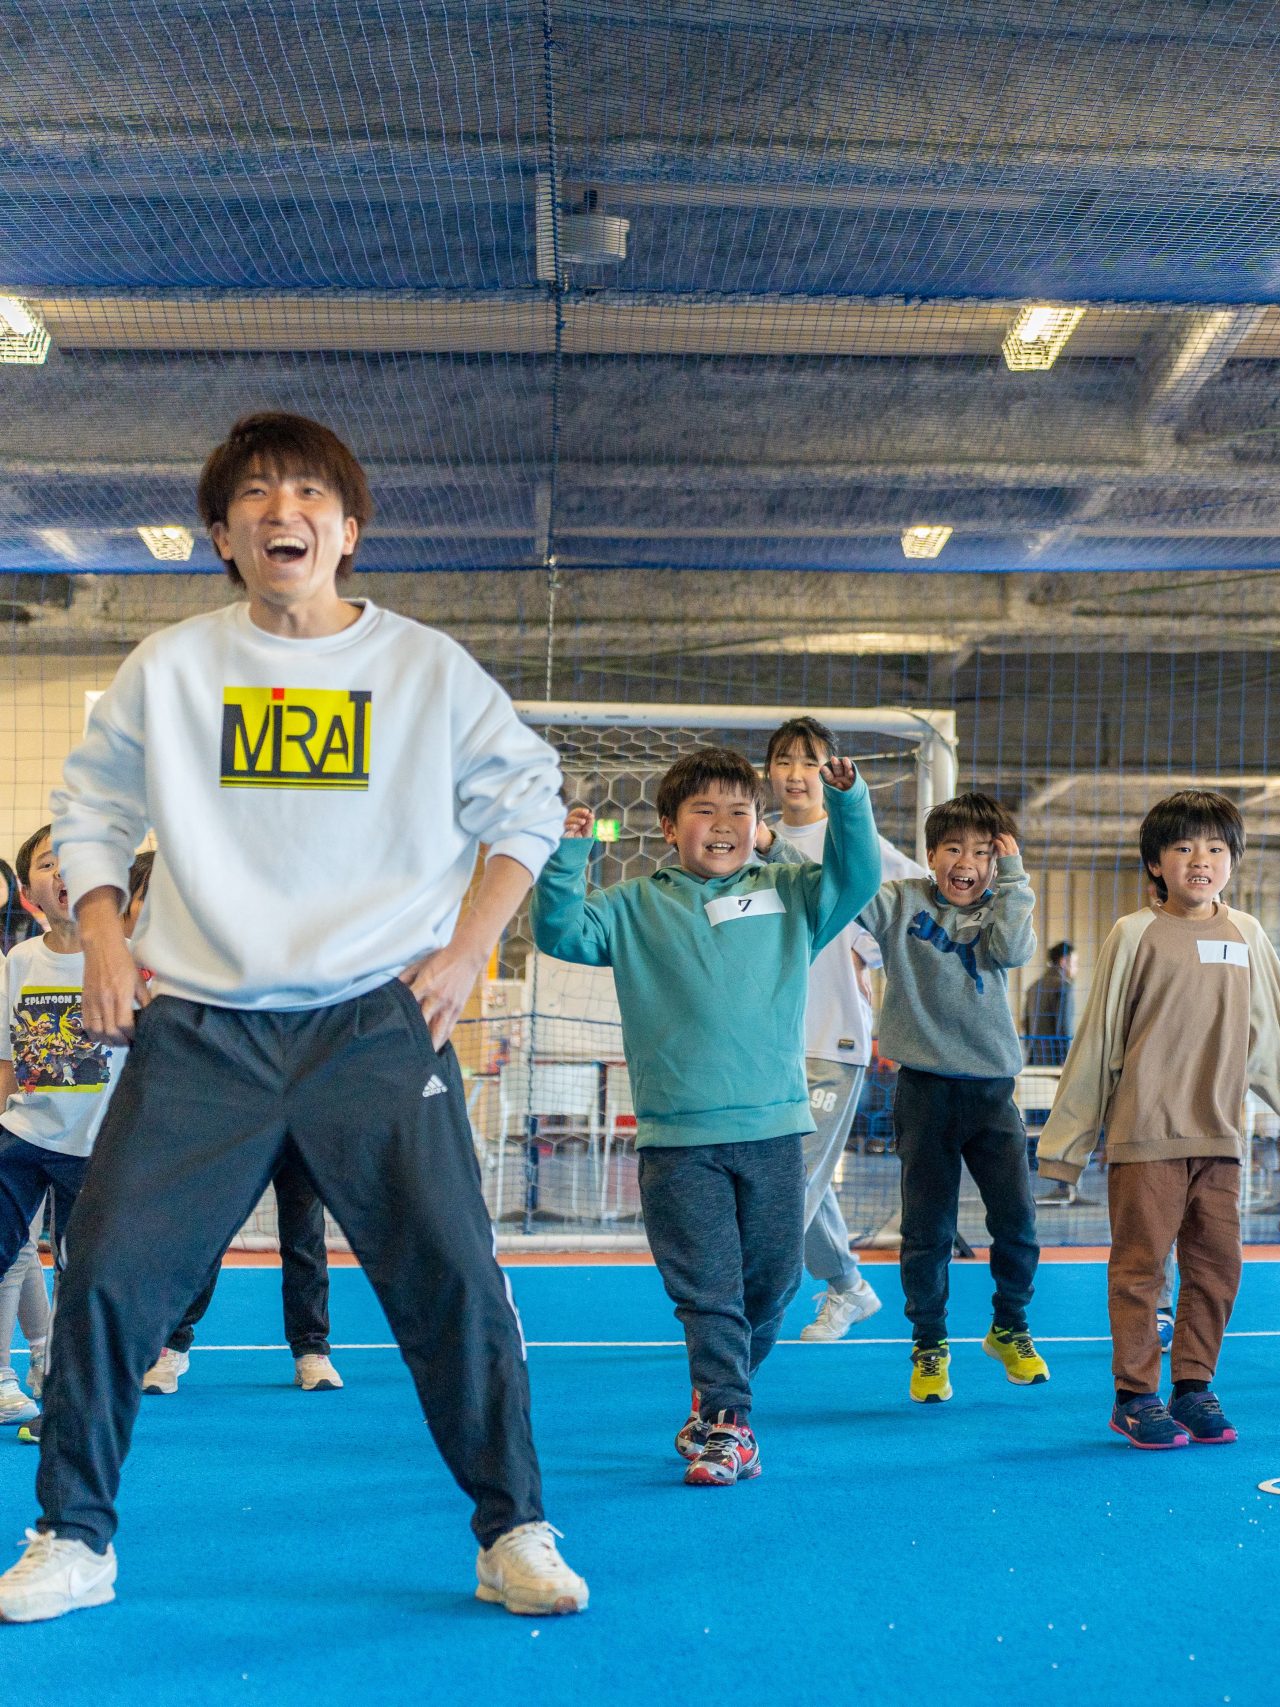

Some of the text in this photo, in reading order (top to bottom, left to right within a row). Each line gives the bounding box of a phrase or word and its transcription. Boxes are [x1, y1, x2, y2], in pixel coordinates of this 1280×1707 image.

[737, 898, 753, 913] 7
[972, 911, 983, 922] 2
[1222, 943, 1229, 961] 1
[24, 995, 72, 1006] SPLATOON
[810, 1088, 838, 1113] 98
